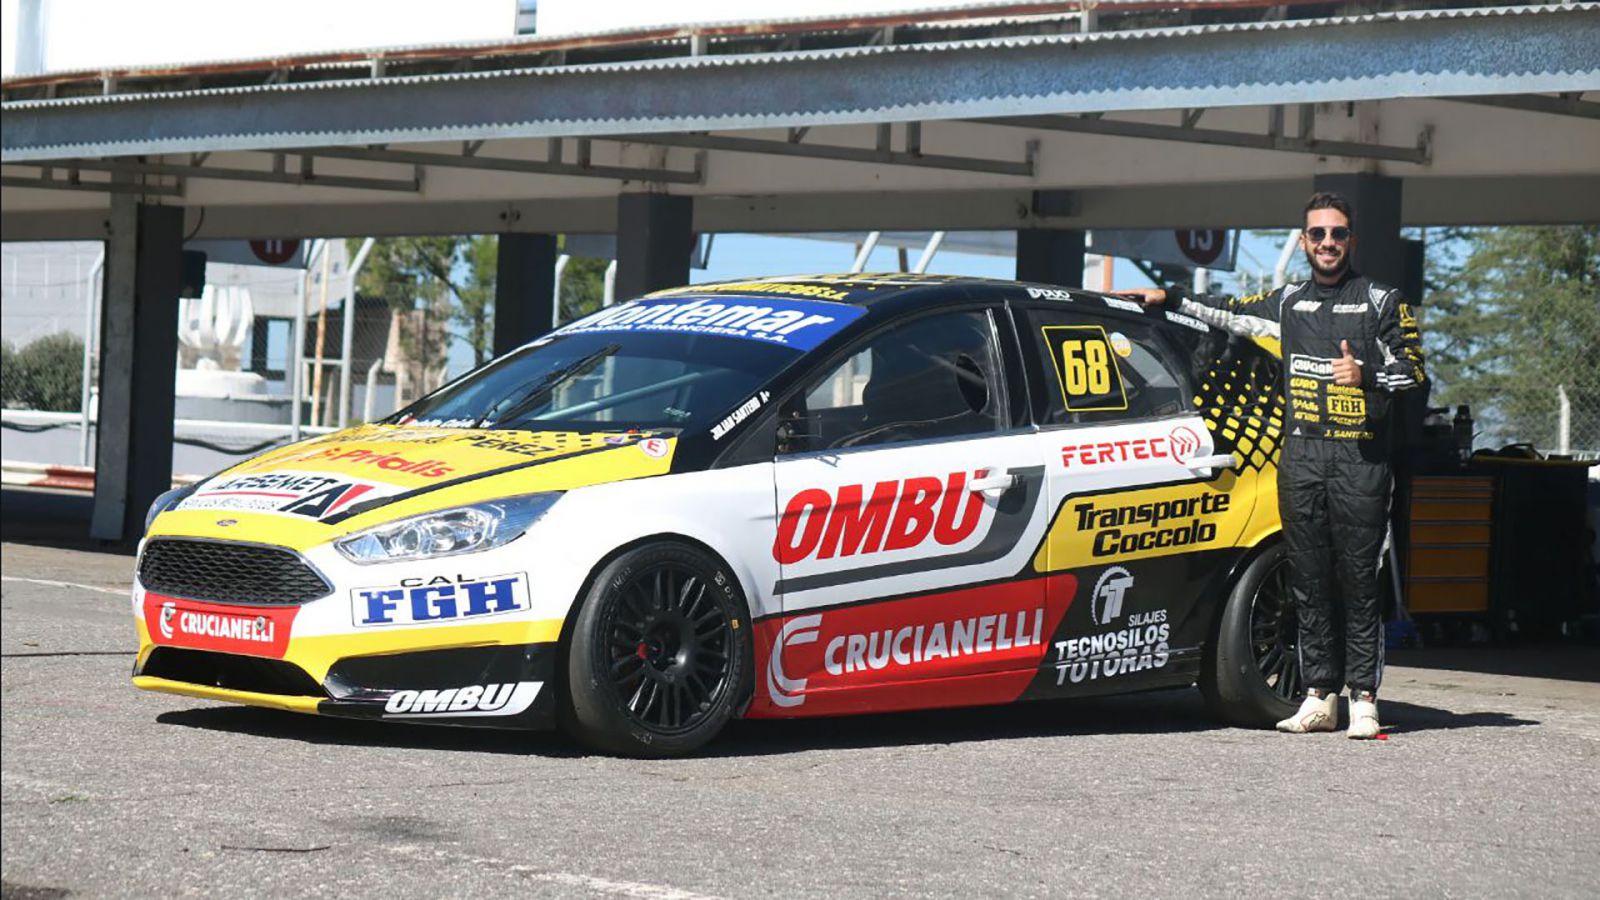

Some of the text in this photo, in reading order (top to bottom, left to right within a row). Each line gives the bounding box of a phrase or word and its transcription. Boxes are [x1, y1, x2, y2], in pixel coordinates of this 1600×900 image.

[1062, 339, 1111, 396] 68
[327, 448, 453, 478] Prialis
[1061, 438, 1168, 467] FERTEC
[1074, 491, 1230, 532] Transporte
[1091, 520, 1218, 558] Coccolo
[400, 574, 476, 588] CAL
[359, 577, 522, 625] FGH
[1127, 609, 1168, 628] SILAJES
[181, 611, 275, 643] CRUCIANELLI
[824, 608, 1044, 676] CRUCIANELLI
[1054, 623, 1171, 661] TECNOSILOS
[1055, 642, 1170, 686] TOTORAS
[384, 683, 516, 714] OMBU
